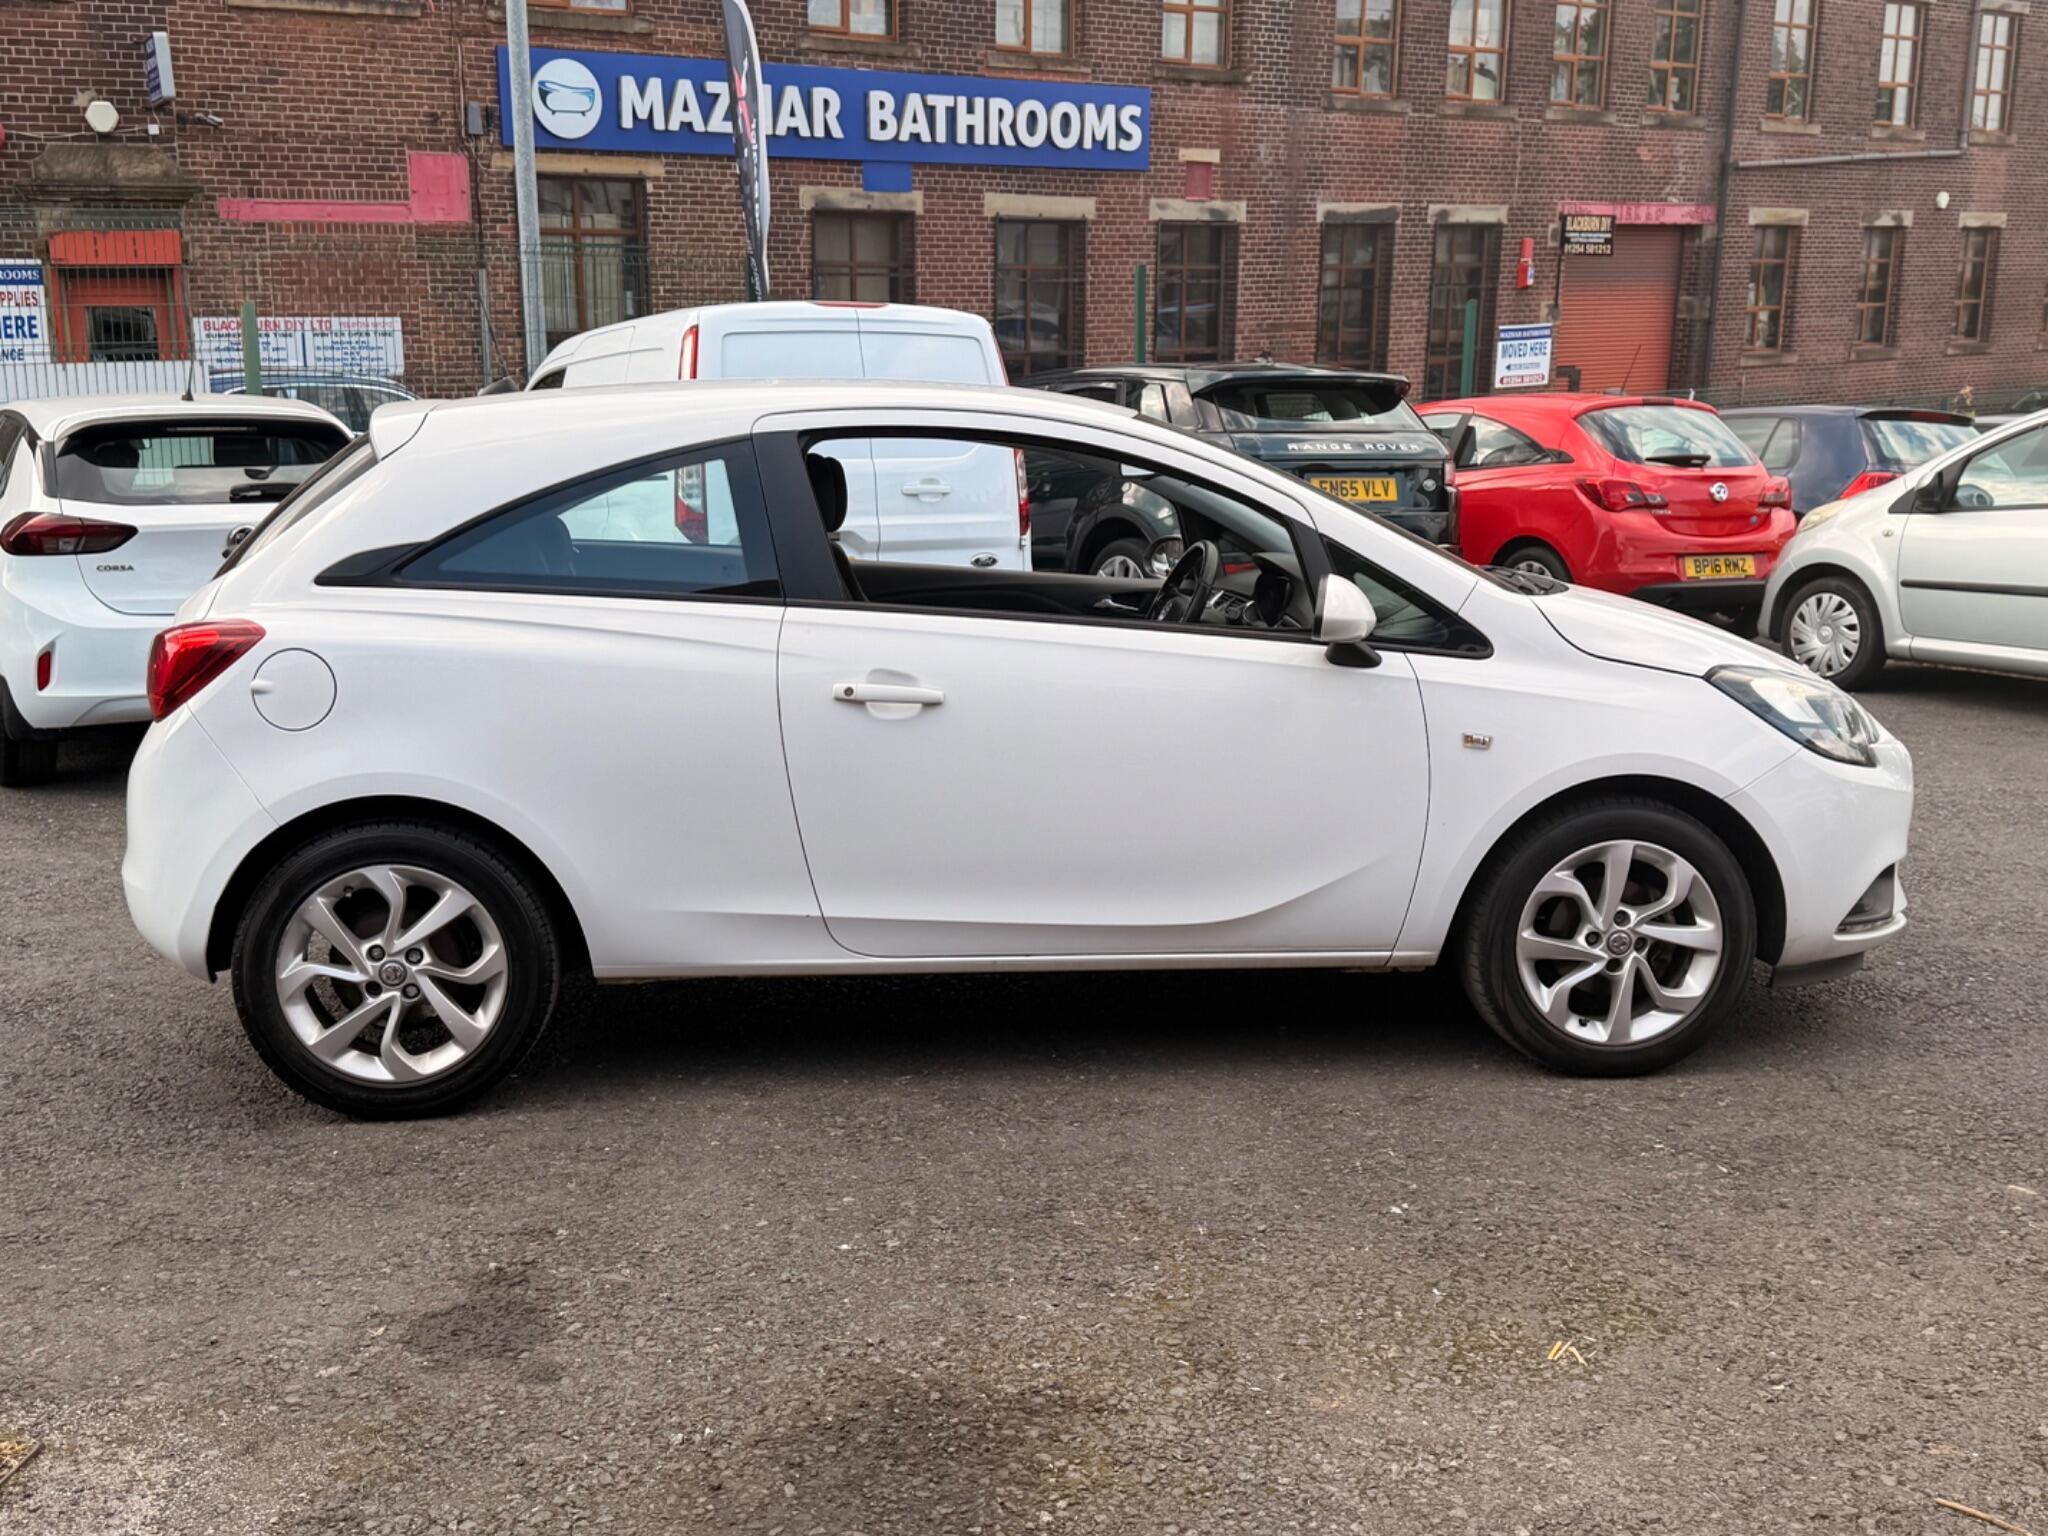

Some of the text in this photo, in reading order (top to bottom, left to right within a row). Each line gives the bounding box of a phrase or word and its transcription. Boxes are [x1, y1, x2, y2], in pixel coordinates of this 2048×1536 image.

[867, 89, 1143, 152] BATHROOMS
[0, 315, 39, 339] ERE
[203, 320, 279, 331] BLACKURN
[284, 320, 304, 331] DIY
[1501, 340, 1547, 358] MOVED HERE
[1287, 443, 1419, 451] RANGE ROVER
[1363, 479, 1390, 497] VLV
[96, 564, 135, 572] CORSA
